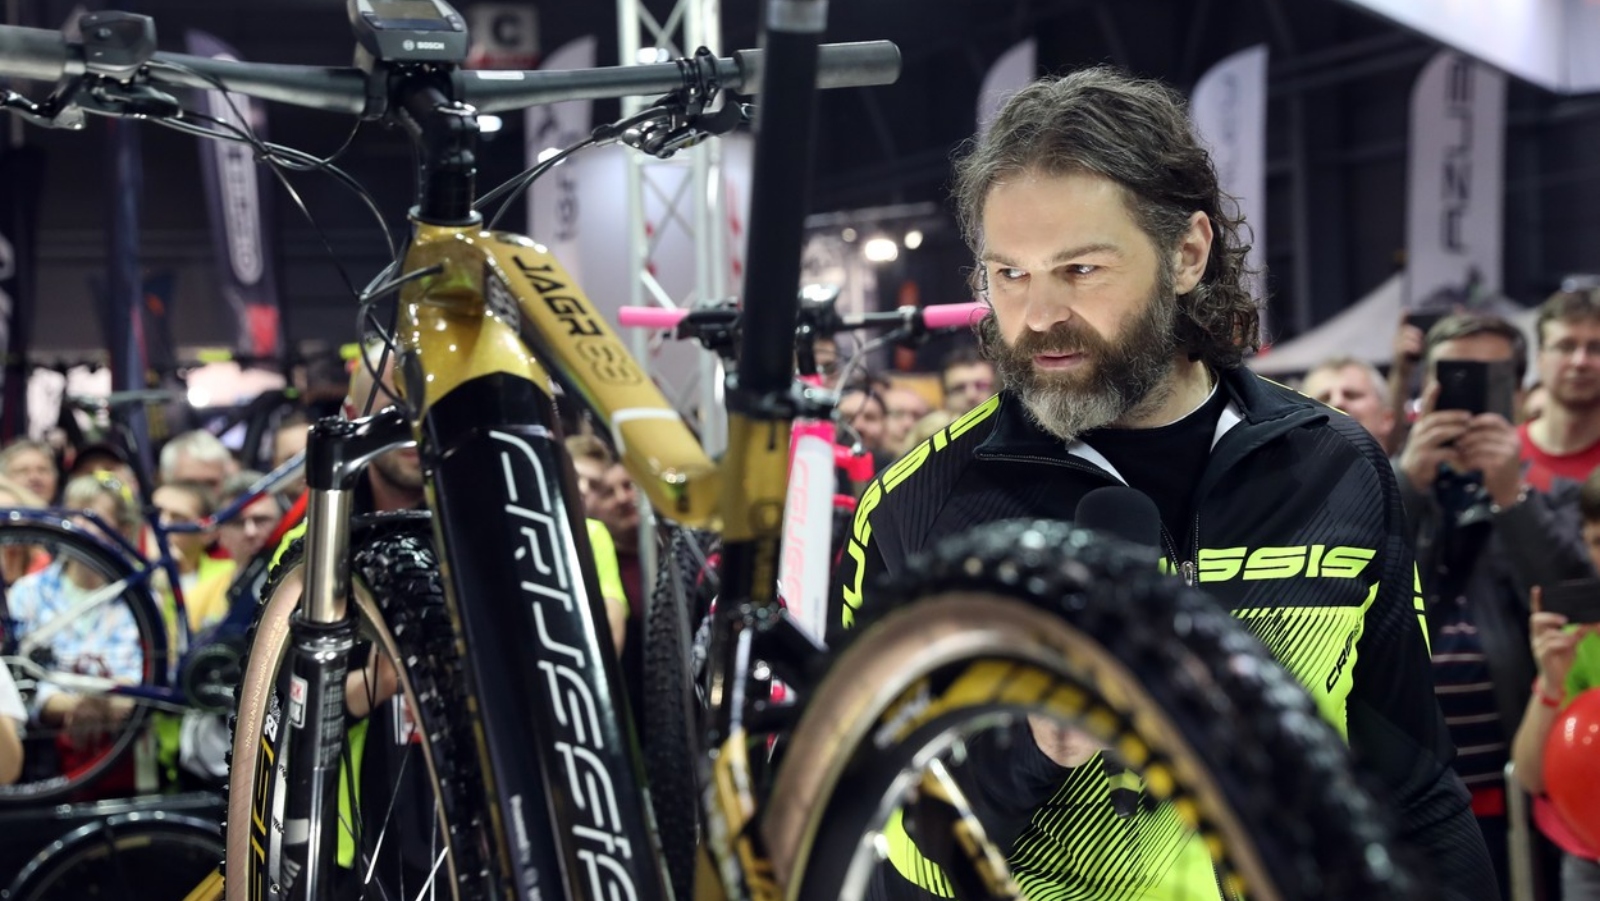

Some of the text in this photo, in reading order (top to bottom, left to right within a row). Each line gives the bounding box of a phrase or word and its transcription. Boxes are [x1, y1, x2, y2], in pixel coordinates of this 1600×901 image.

[416, 41, 445, 50] BOSCH
[511, 254, 604, 336] JAGR
[842, 392, 999, 629] USSIS
[1158, 544, 1377, 582] SSIS
